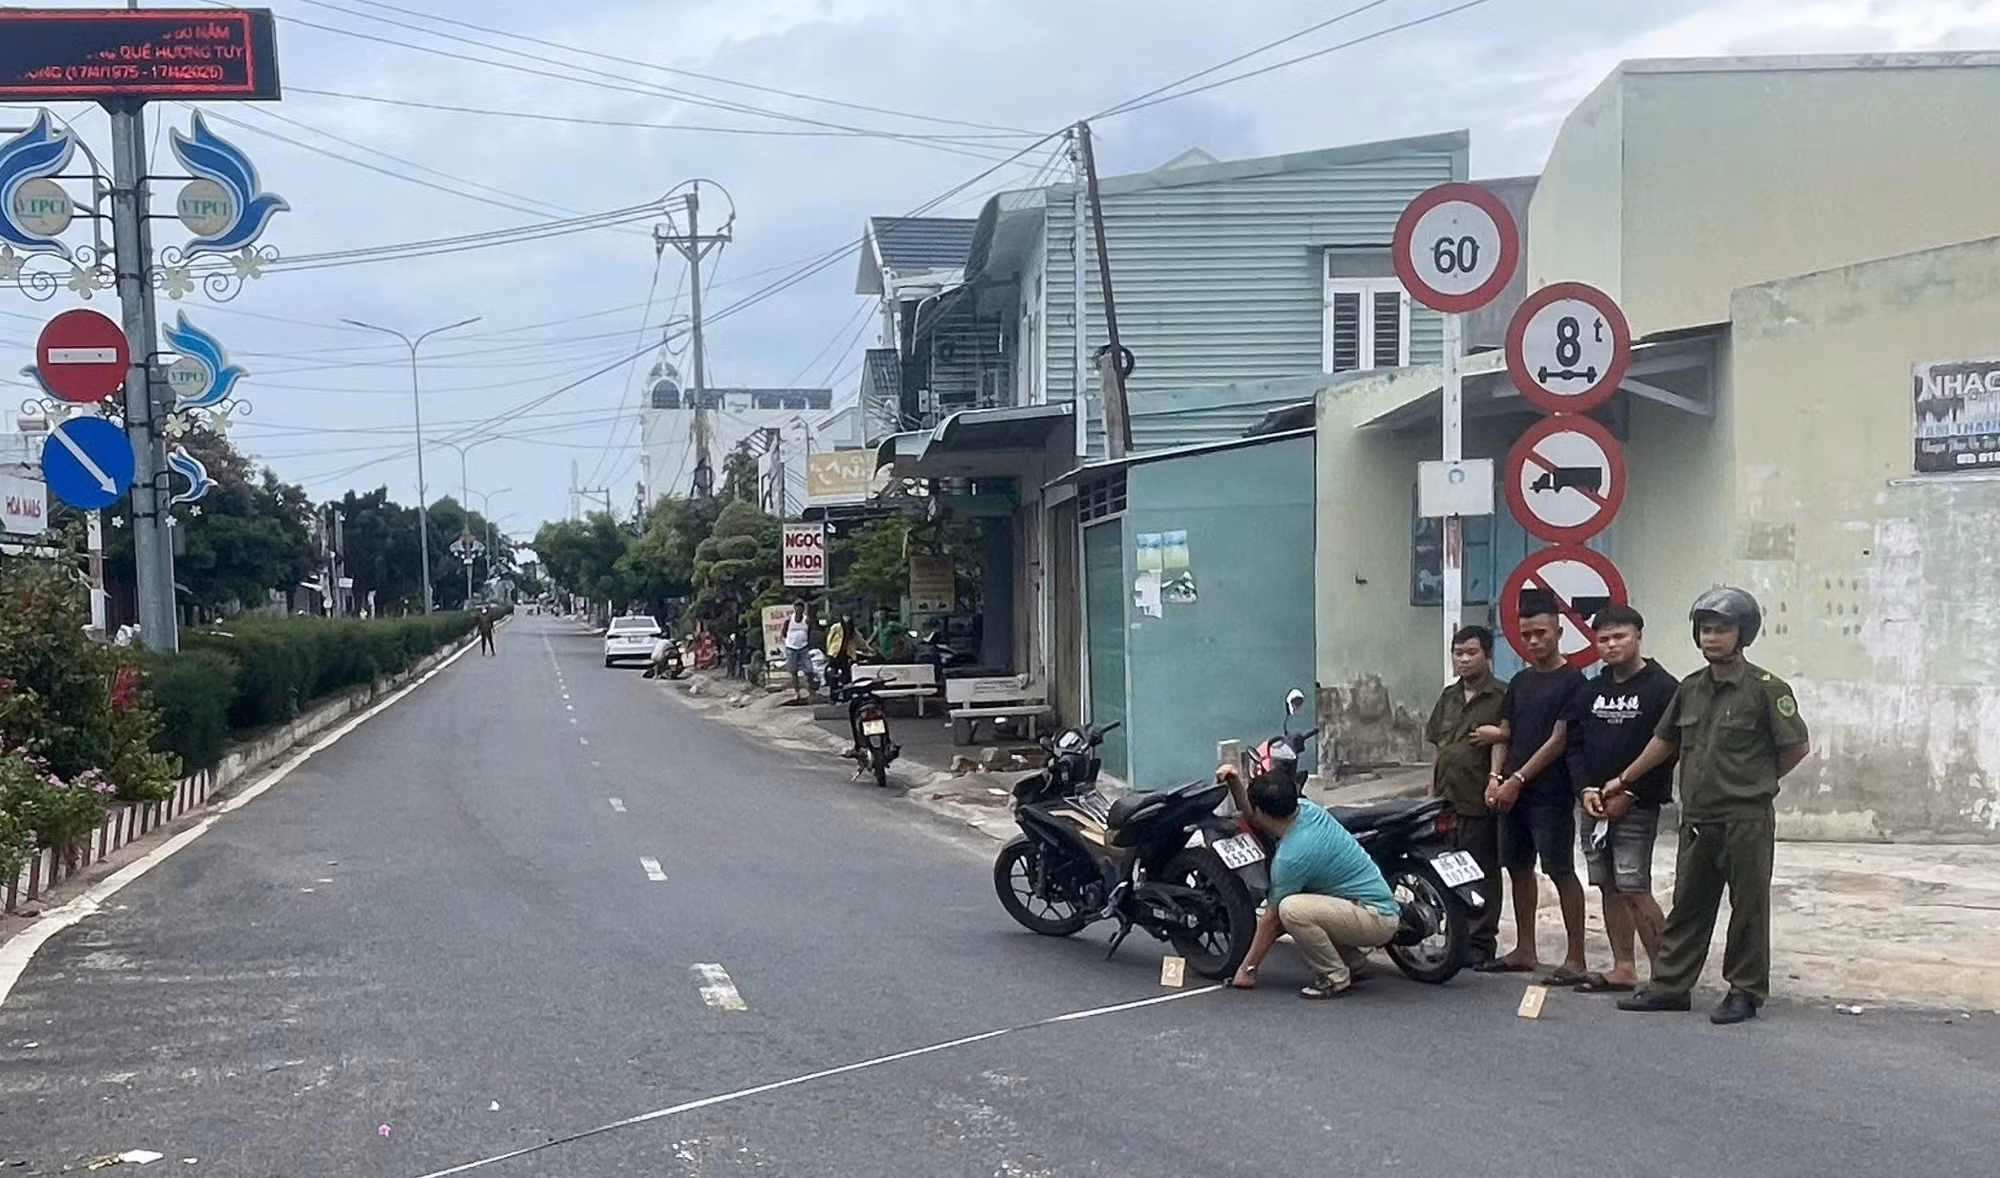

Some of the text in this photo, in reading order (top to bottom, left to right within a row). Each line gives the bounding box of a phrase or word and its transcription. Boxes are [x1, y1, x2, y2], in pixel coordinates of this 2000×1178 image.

[120, 43, 151, 59] QUÊ
[1433, 235, 1479, 274] 60
[1556, 316, 1582, 368] 8
[785, 554, 823, 569] KHOA
[1166, 962, 1177, 978] 2
